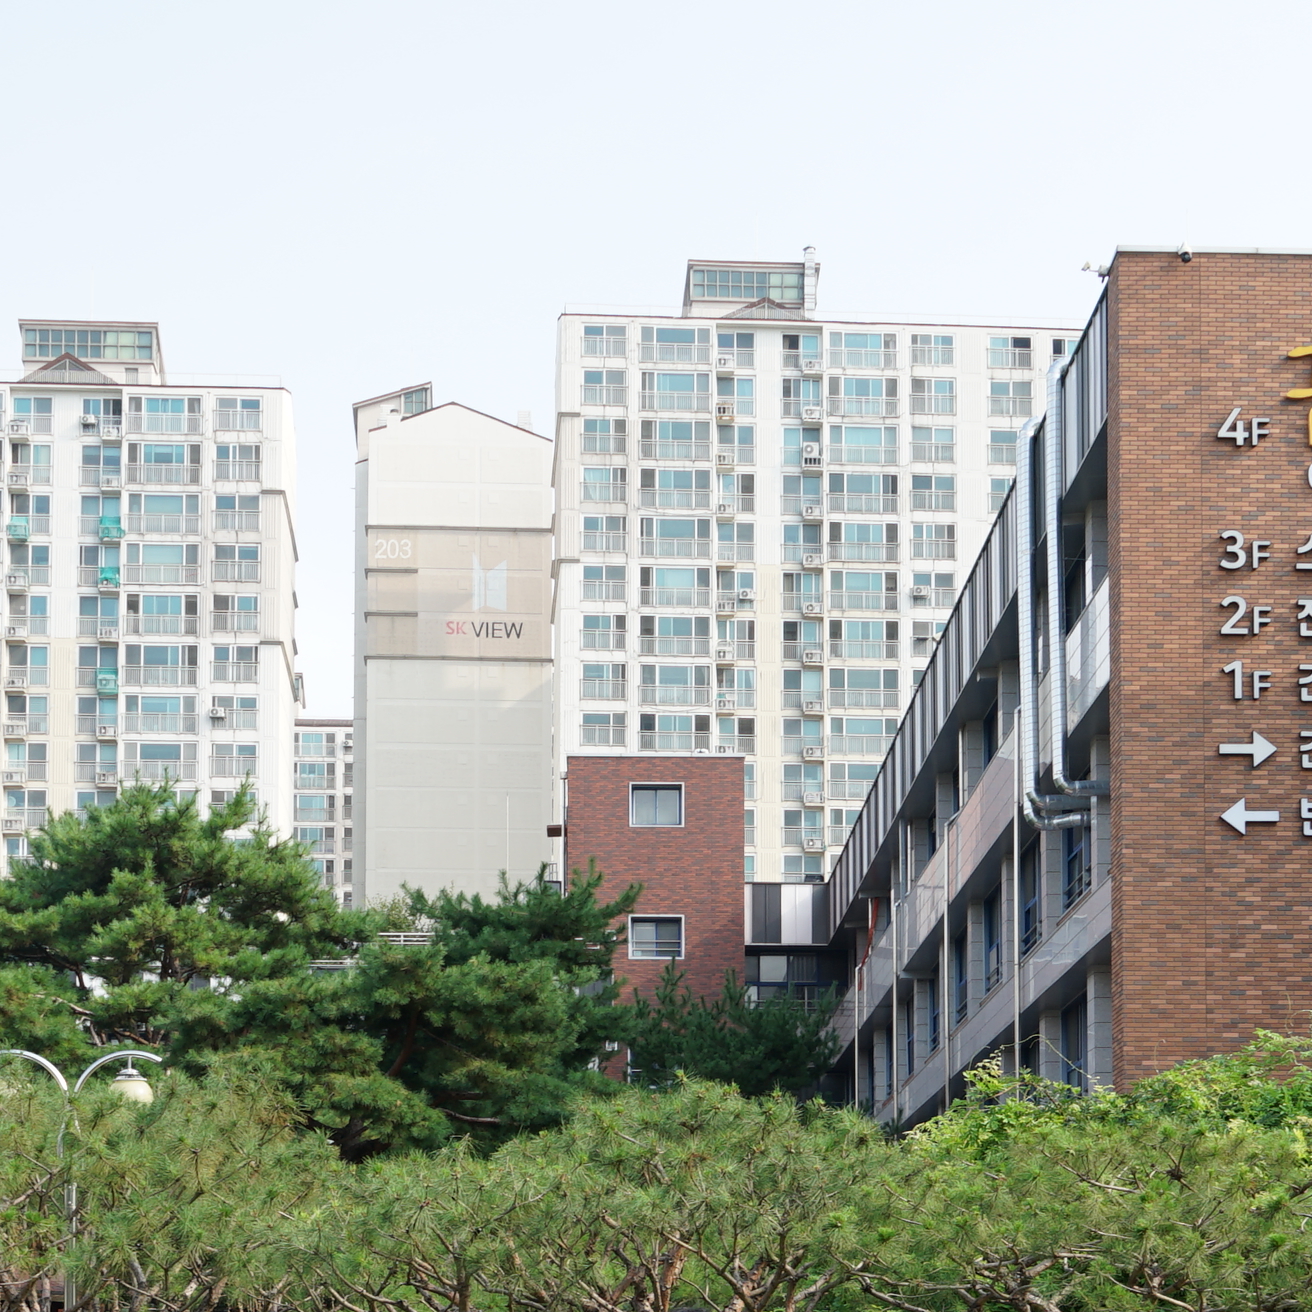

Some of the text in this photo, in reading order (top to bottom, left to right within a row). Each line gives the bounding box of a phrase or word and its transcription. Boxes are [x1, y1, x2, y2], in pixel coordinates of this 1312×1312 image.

[1217, 407, 1270, 446] 4F
[374, 539, 412, 559] 203
[1219, 530, 1272, 570] 3F
[445, 620, 524, 640] SK VIEW
[1220, 595, 1273, 636] 2F
[1222, 660, 1273, 700] 1F
